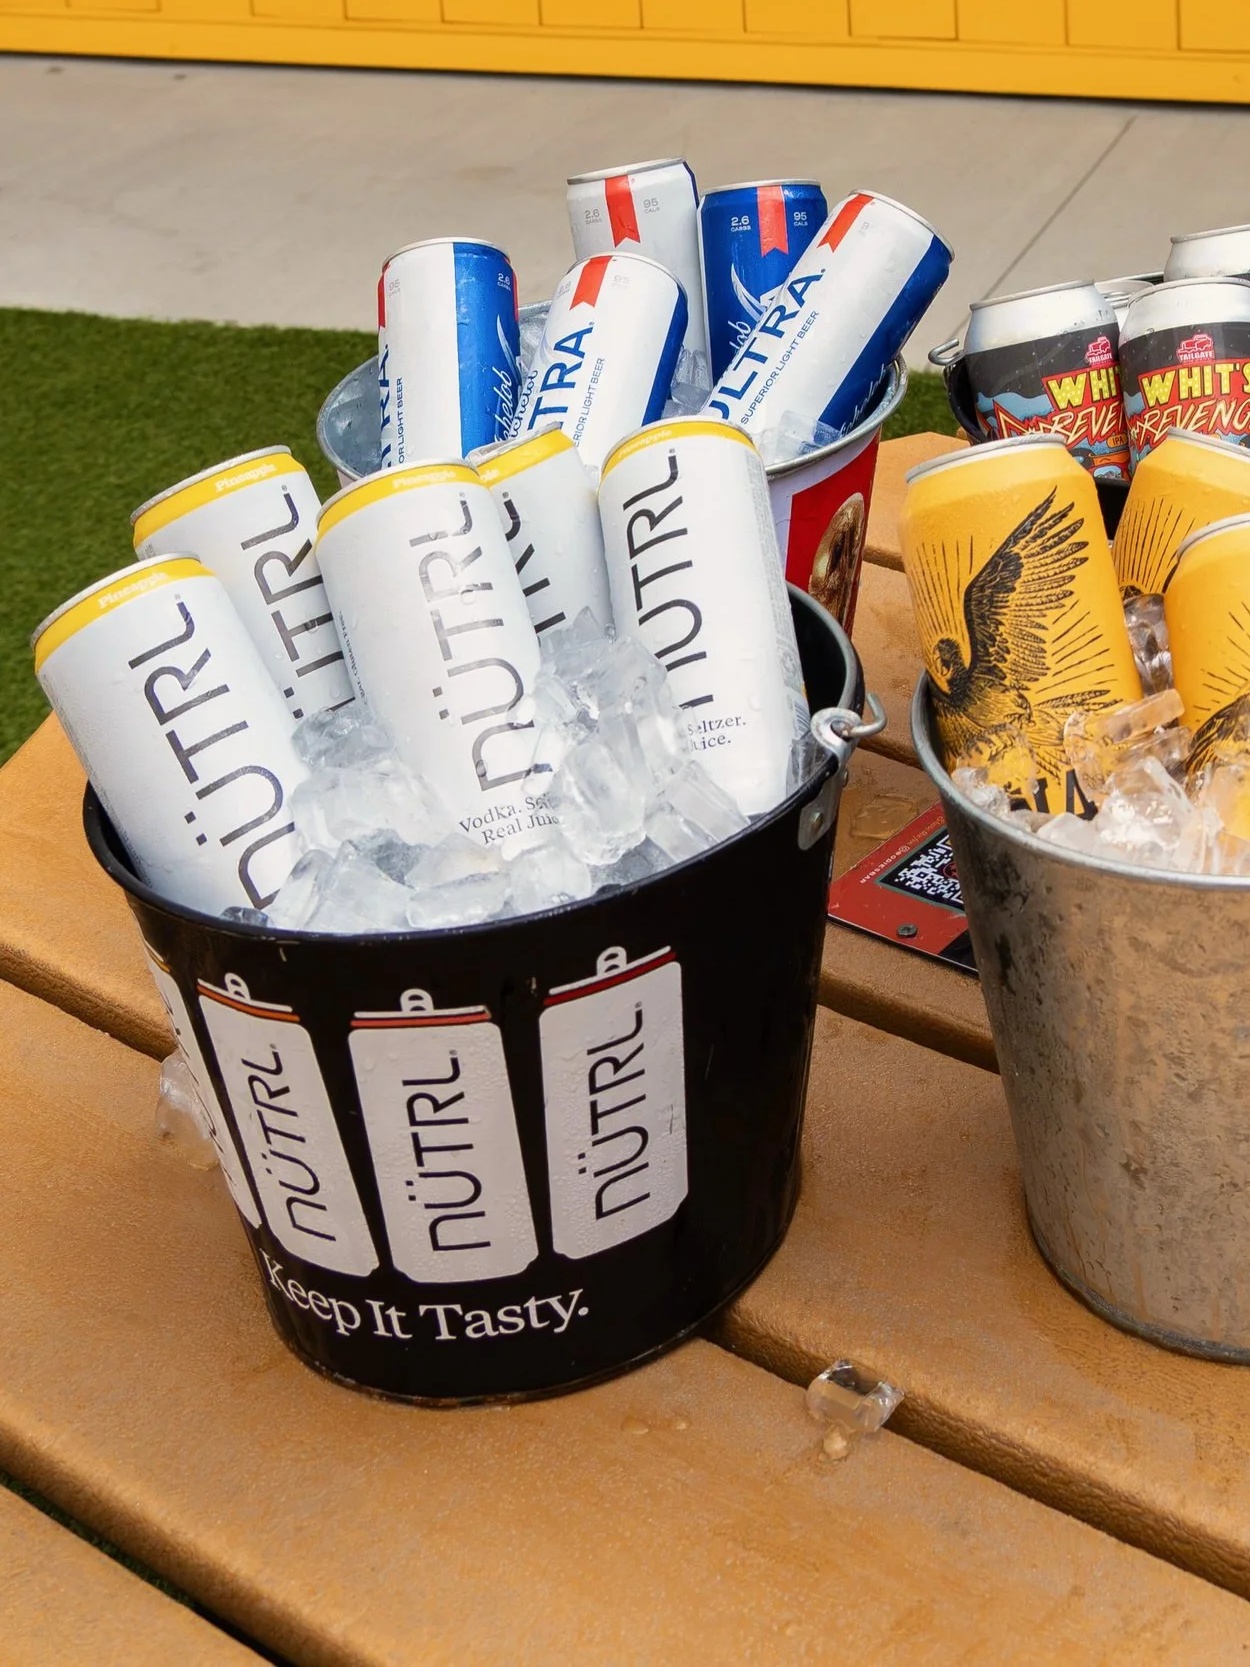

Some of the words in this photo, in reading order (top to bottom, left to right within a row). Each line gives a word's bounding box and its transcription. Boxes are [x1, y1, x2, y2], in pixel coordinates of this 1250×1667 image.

[584, 208, 600, 220] 2.6
[731, 215, 750, 227] 2.6
[793, 211, 808, 222] 95
[740, 367, 781, 425] SUPERIOR
[777, 338, 800, 373] LIGHT
[798, 310, 819, 340] BEER
[1178, 350, 1213, 362] TAILGATE
[396, 377, 404, 409] BEER
[527, 326, 594, 431] TRA
[582, 383, 596, 417] LIGHT
[590, 357, 606, 385] BEER
[1048, 364, 1122, 411] WHI
[396, 411, 405, 447] LIGHT
[1111, 435, 1126, 446] IPA
[215, 462, 277, 493] Pineapple
[97, 571, 169, 610] Pineapple
[458, 805, 523, 835] Vodka.
[482, 822, 525, 846] Real
[260, 1248, 361, 1336] Keep
[366, 1299, 412, 1340] It
[418, 1286, 590, 1342] Tasty.
